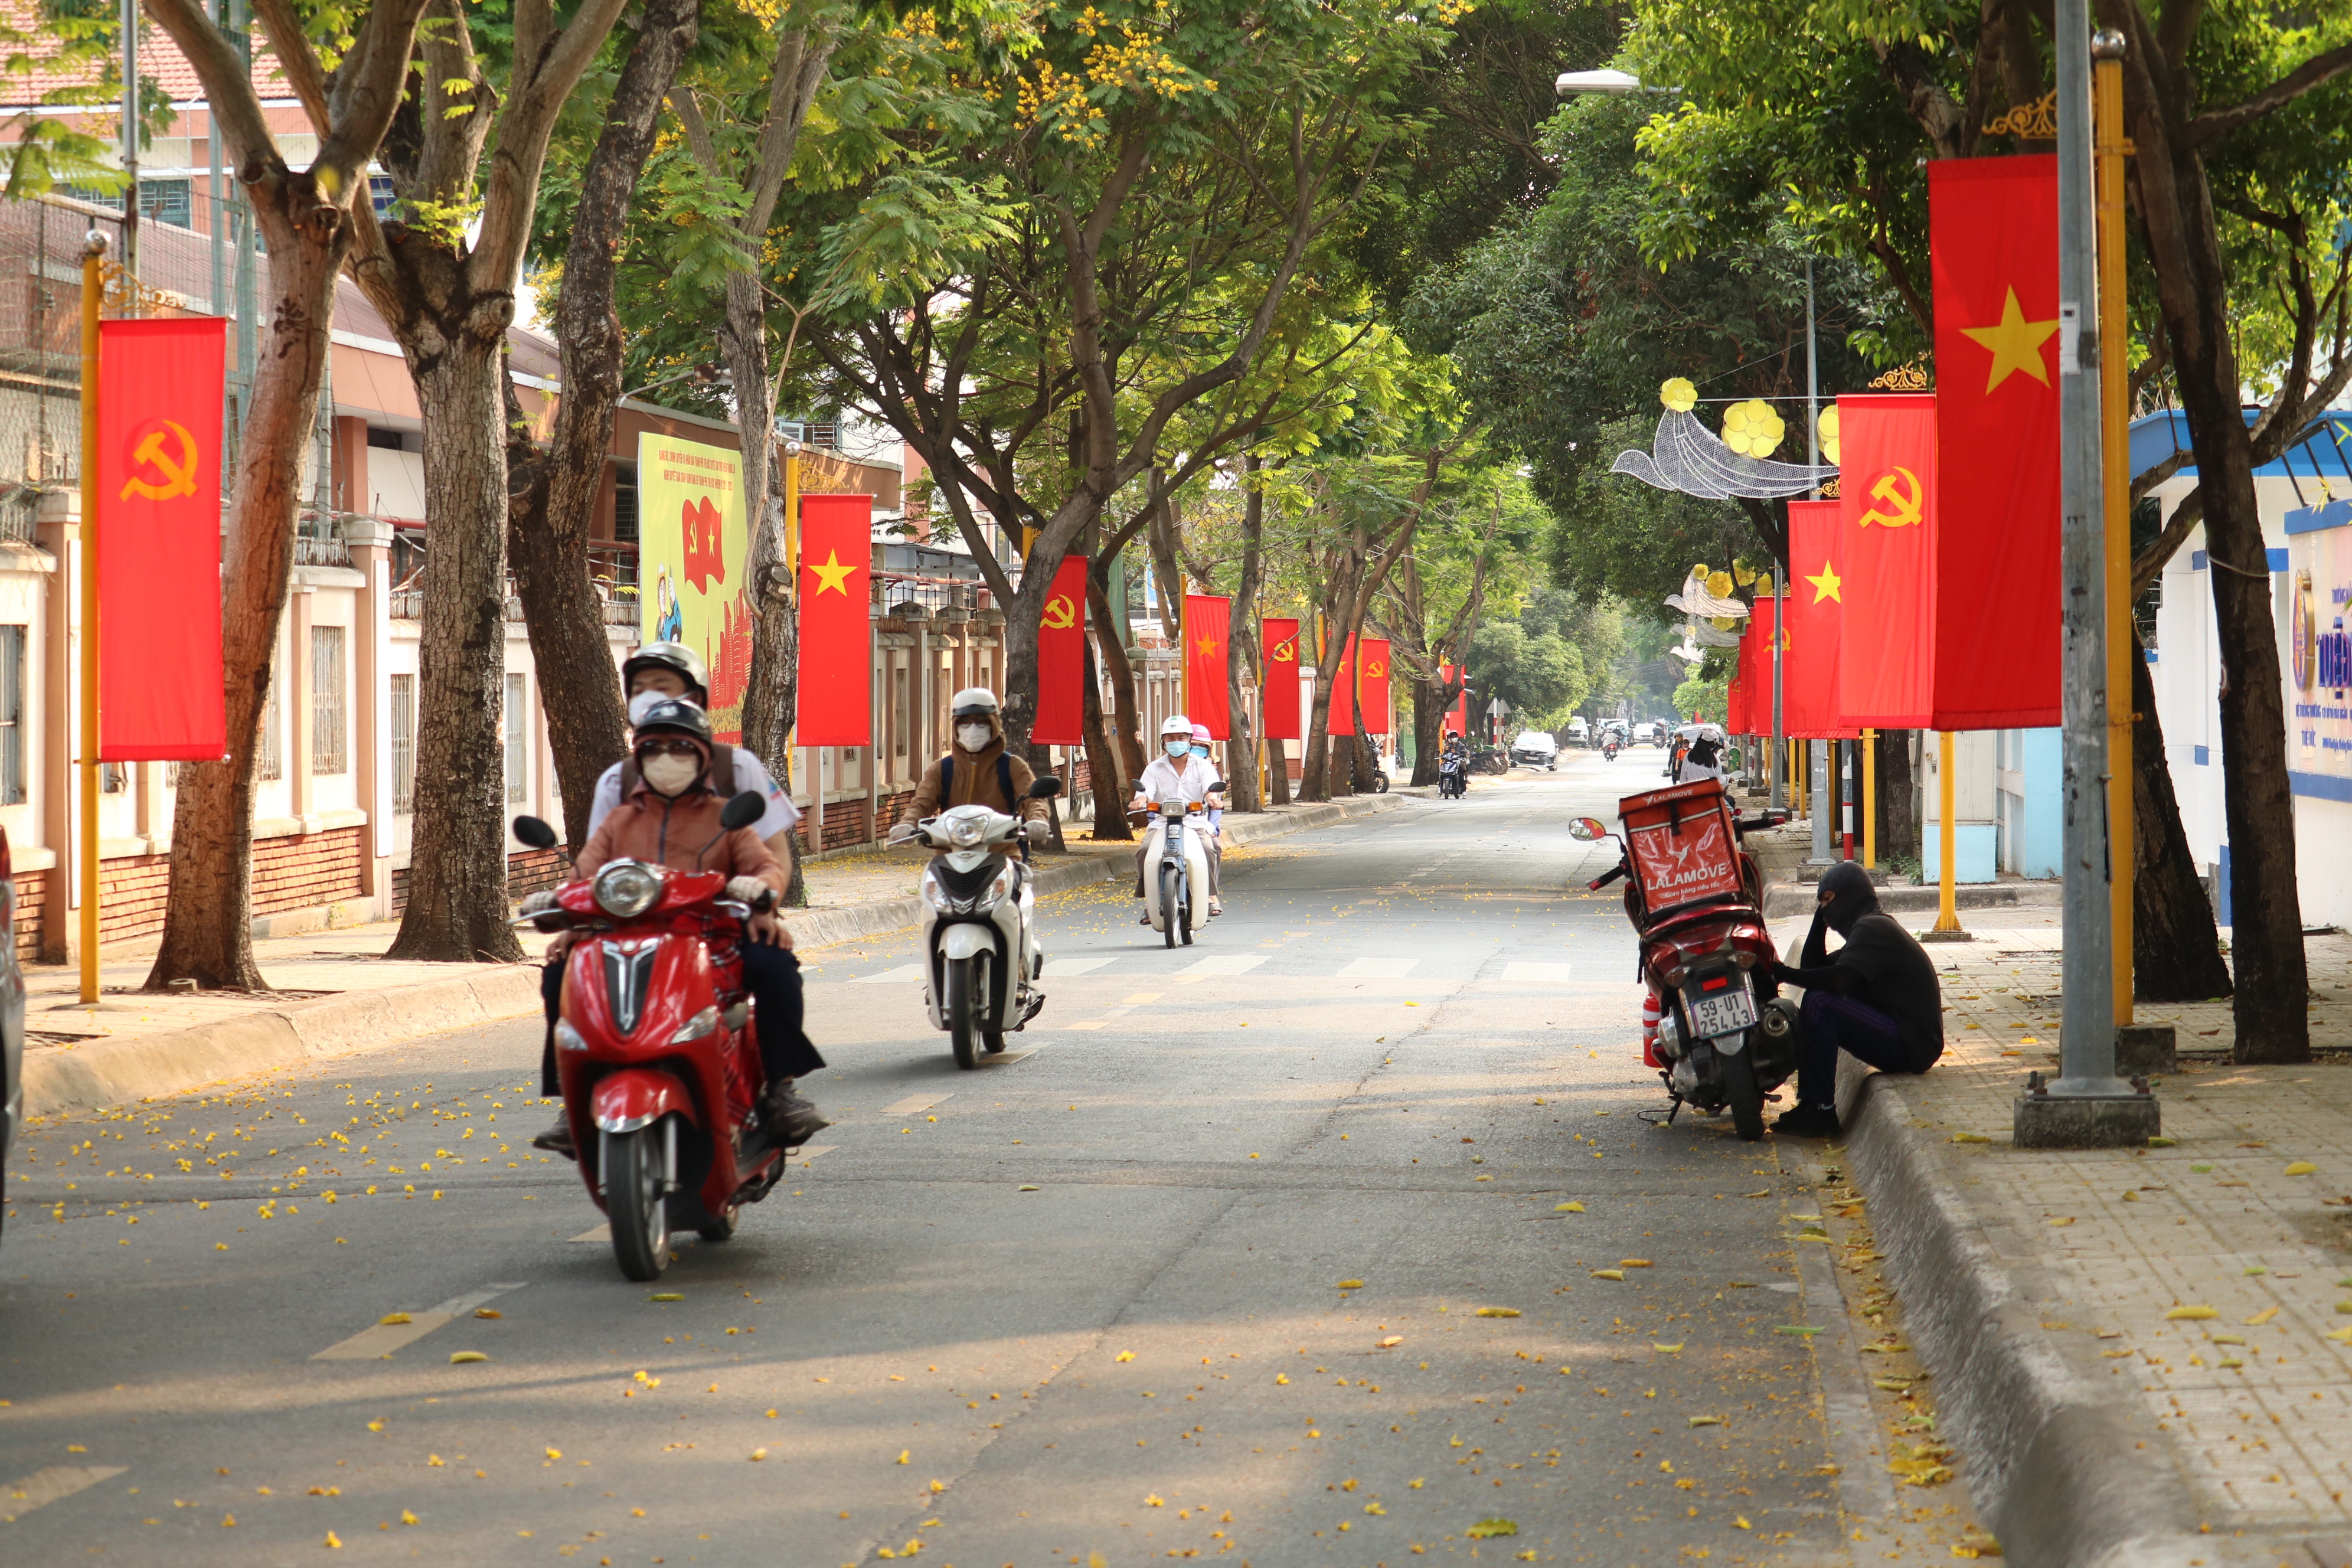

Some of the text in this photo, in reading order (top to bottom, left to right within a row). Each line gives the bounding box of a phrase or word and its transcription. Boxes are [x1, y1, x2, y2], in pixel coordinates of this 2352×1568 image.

[1654, 789, 1693, 803] LALAMOVE
[1647, 863, 1727, 891] LALAMOVE
[1681, 886, 1696, 895] hàng
[1697, 883, 1710, 891] siêu
[1700, 994, 1739, 1018] 59-U1
[1700, 1010, 1750, 1036] 254.43
